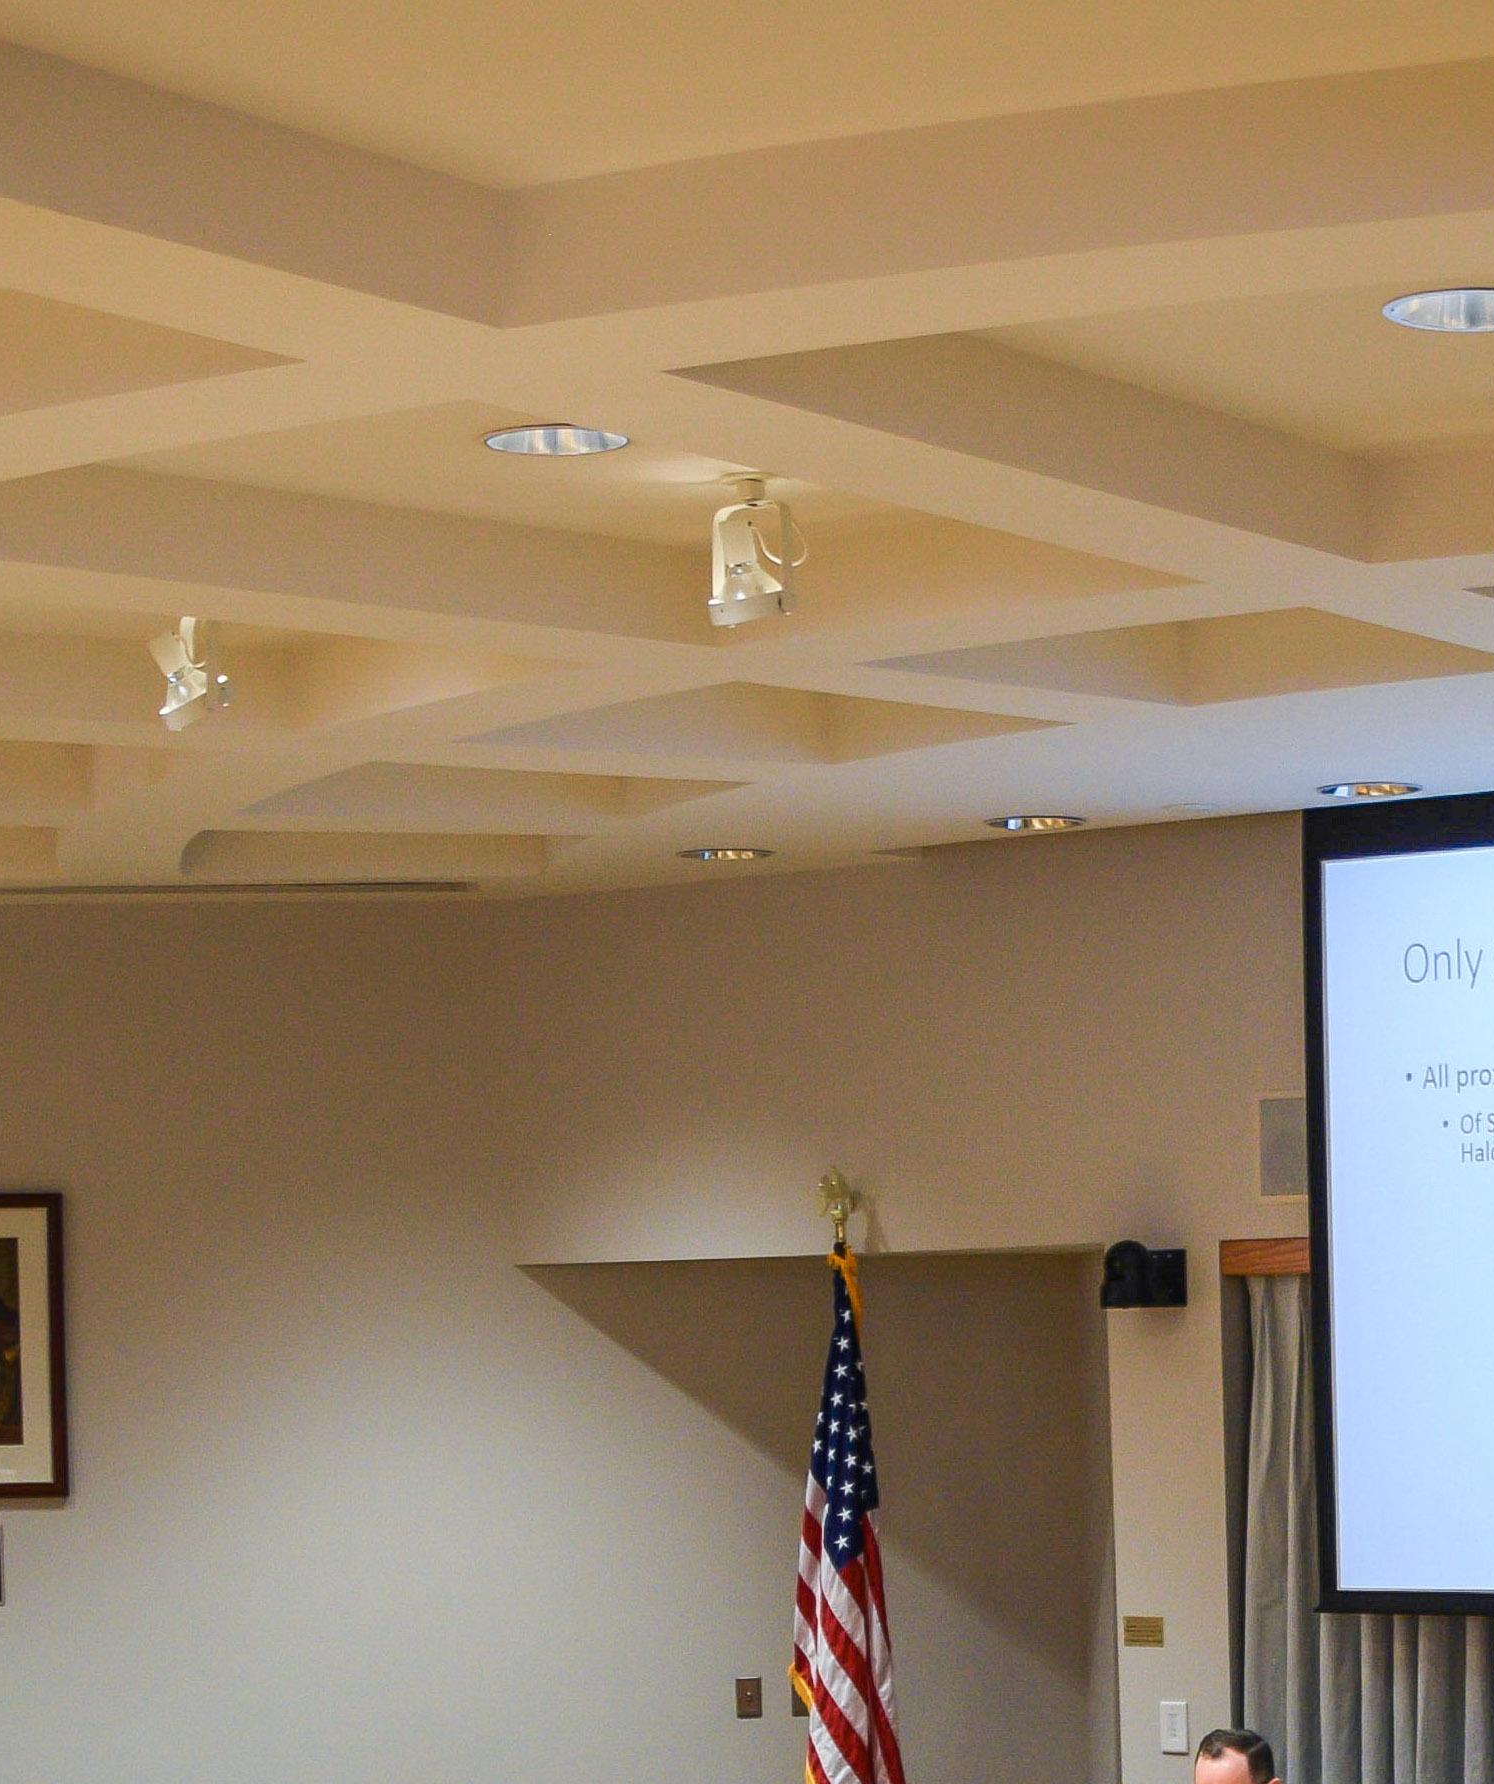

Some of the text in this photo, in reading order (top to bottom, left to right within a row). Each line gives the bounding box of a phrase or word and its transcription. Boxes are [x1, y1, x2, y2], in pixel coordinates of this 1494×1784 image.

[1403, 938, 1483, 989] Only
[1422, 1063, 1449, 1090] All
[1460, 1112, 1482, 1134] Of
